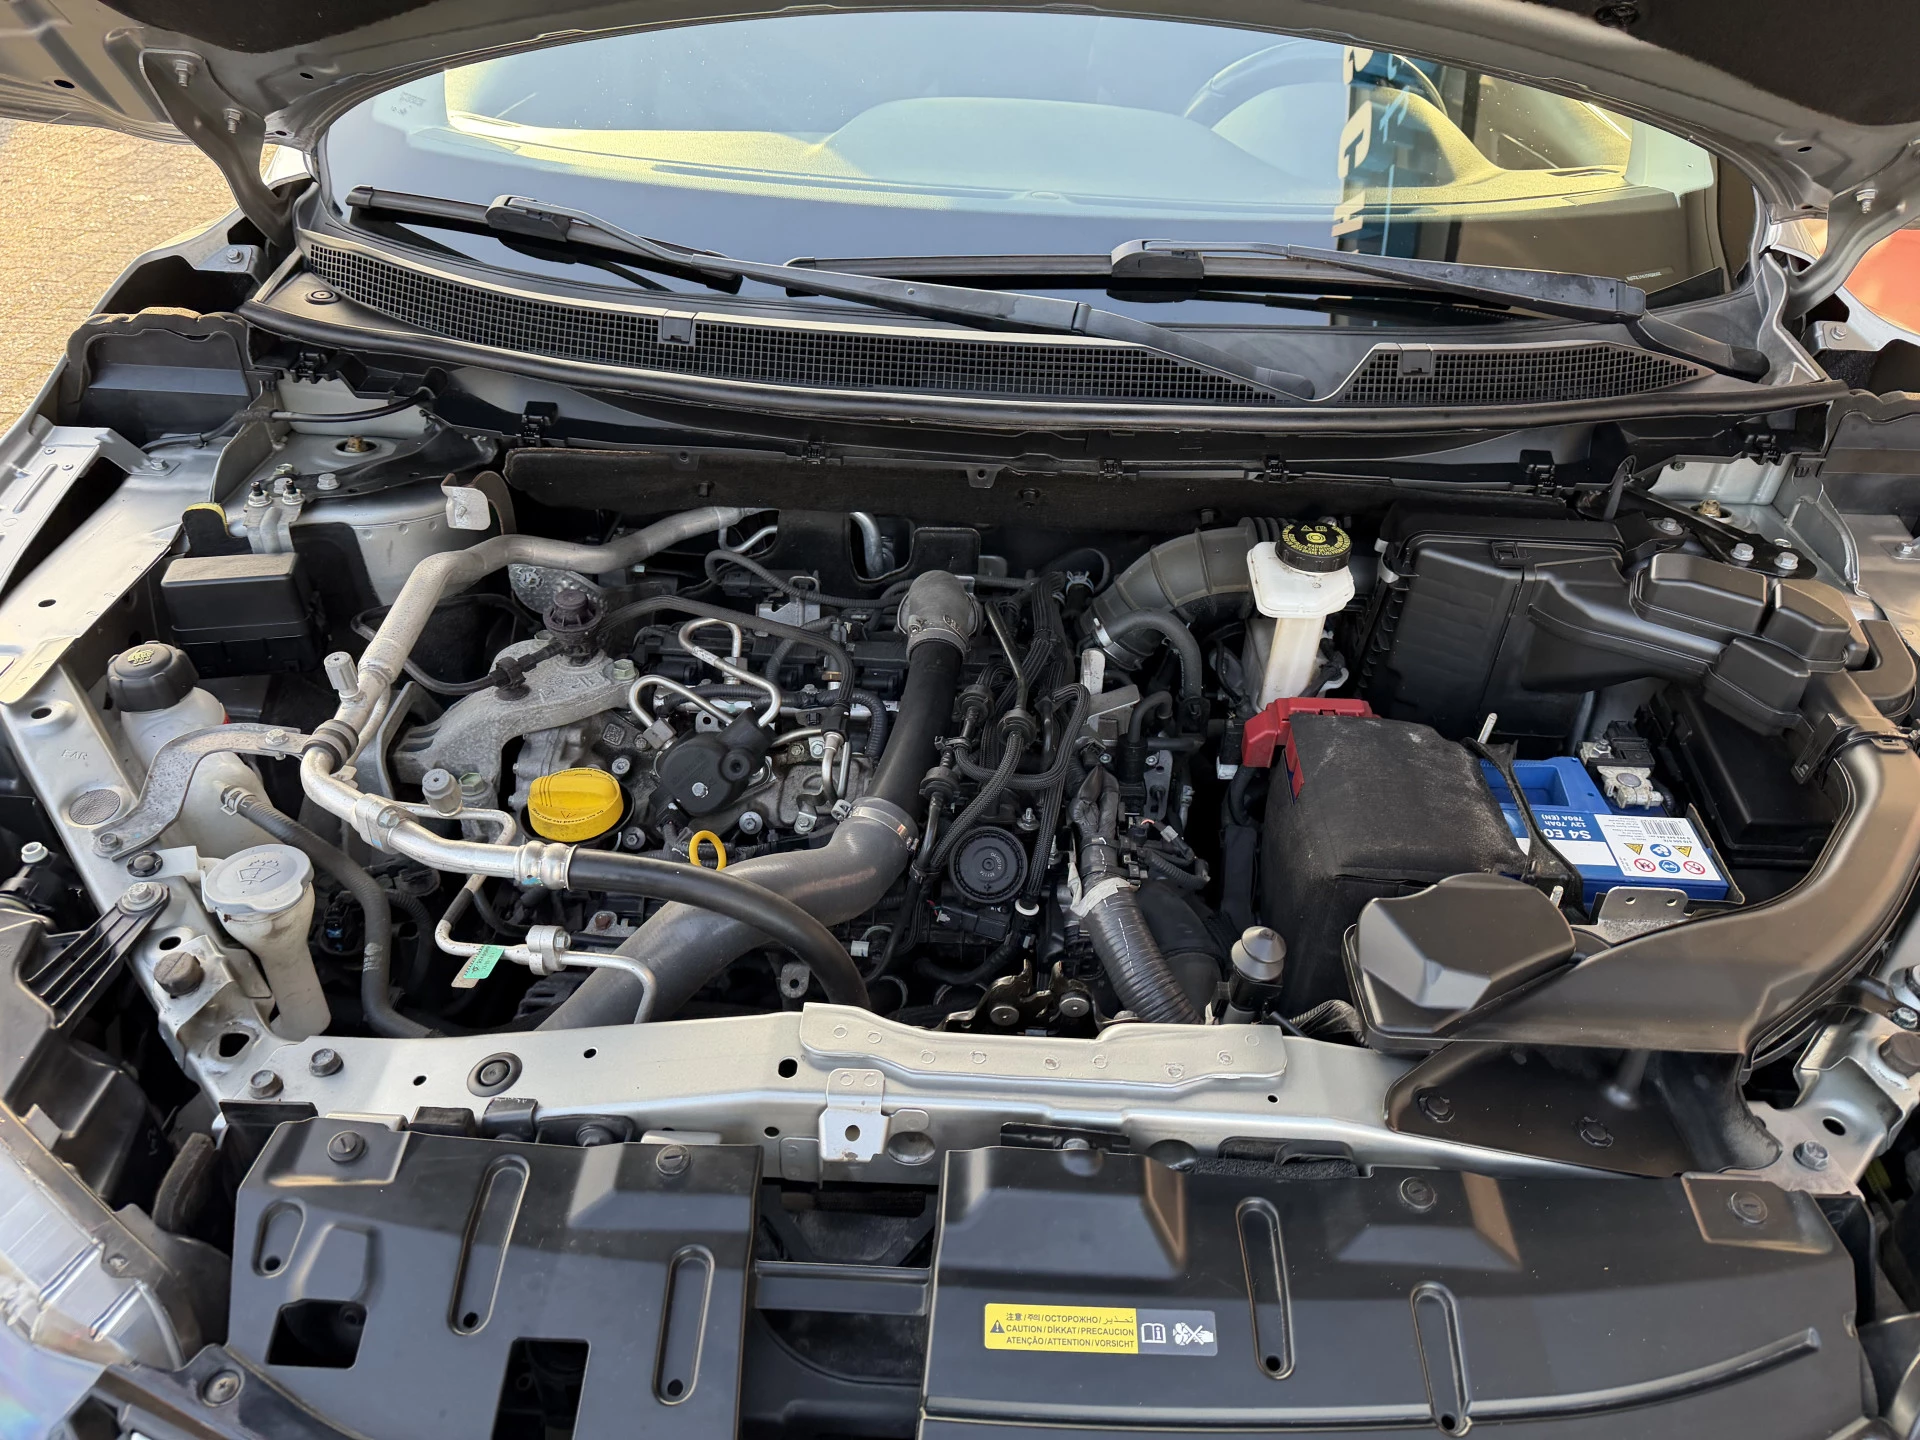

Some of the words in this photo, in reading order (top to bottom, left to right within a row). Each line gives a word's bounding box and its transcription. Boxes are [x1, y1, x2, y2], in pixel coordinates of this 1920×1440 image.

[1541, 813, 1560, 821] (EN)
[1541, 828, 1565, 838] E0
[1568, 829, 1592, 840] S4
[1006, 1312, 1023, 1322] 注意
[1045, 1314, 1099, 1324] ОСТОРОЖНО
[1006, 1324, 1043, 1333] CAUTION
[1081, 1327, 1134, 1336] PRECAUCION
[1006, 1336, 1044, 1346] ATENÇÃO
[1047, 1337, 1091, 1347] ATTENTION
[1094, 1339, 1135, 1348] VORSICHT
